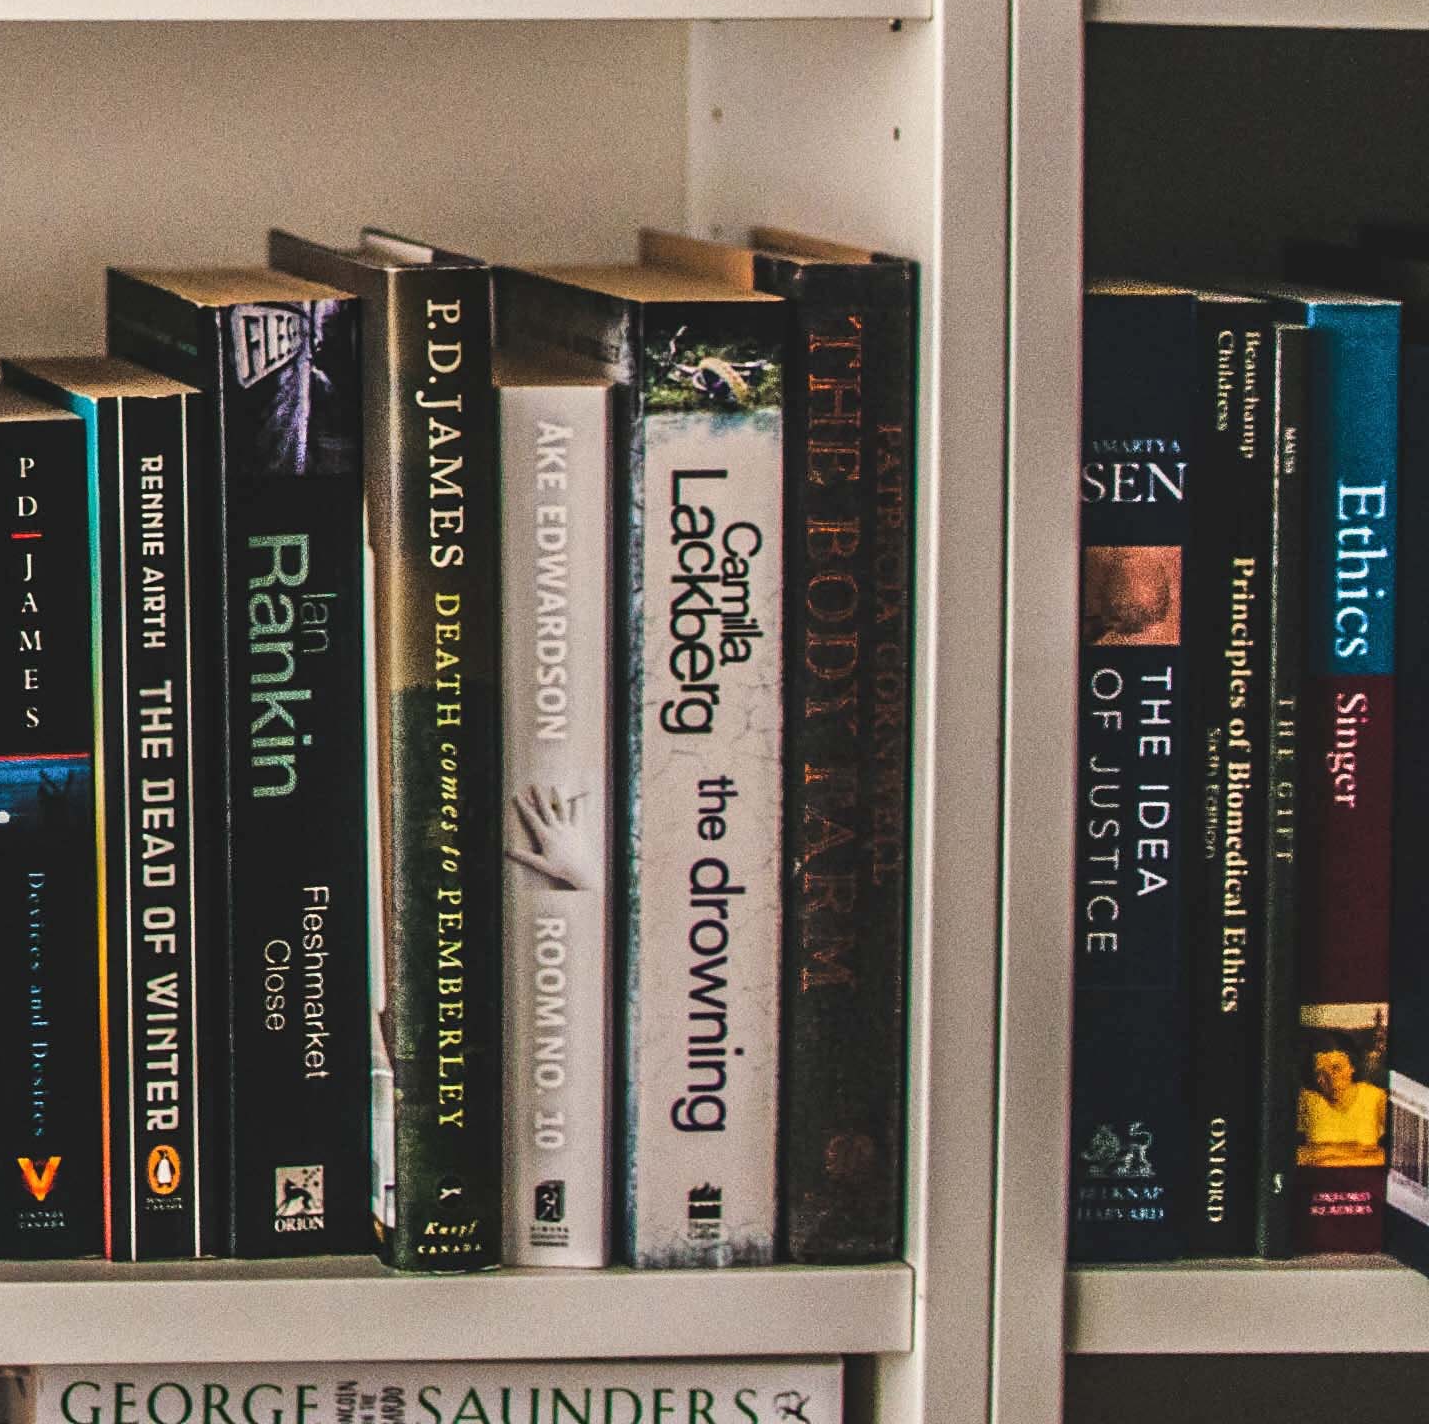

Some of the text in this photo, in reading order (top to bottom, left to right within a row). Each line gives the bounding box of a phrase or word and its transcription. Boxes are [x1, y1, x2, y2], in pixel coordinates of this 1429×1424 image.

[1334, 479, 1389, 659] Ethics
[139, 455, 180, 1131] RENNIE AIRTH THE DEAD OF WINTER
[434, 593, 464, 1128] DEATH PEMBERLEY
[1085, 668, 1124, 954] OF JUSTICE
[1137, 666, 1172, 897] THE IDEA
[1219, 556, 1256, 1013] Principles Ethics
[264, 940, 292, 1031] Close
[303, 885, 331, 1081] Fleshmarket
[670, 775, 747, 1133] the drowning
[275, 1215, 324, 1233] ORION
